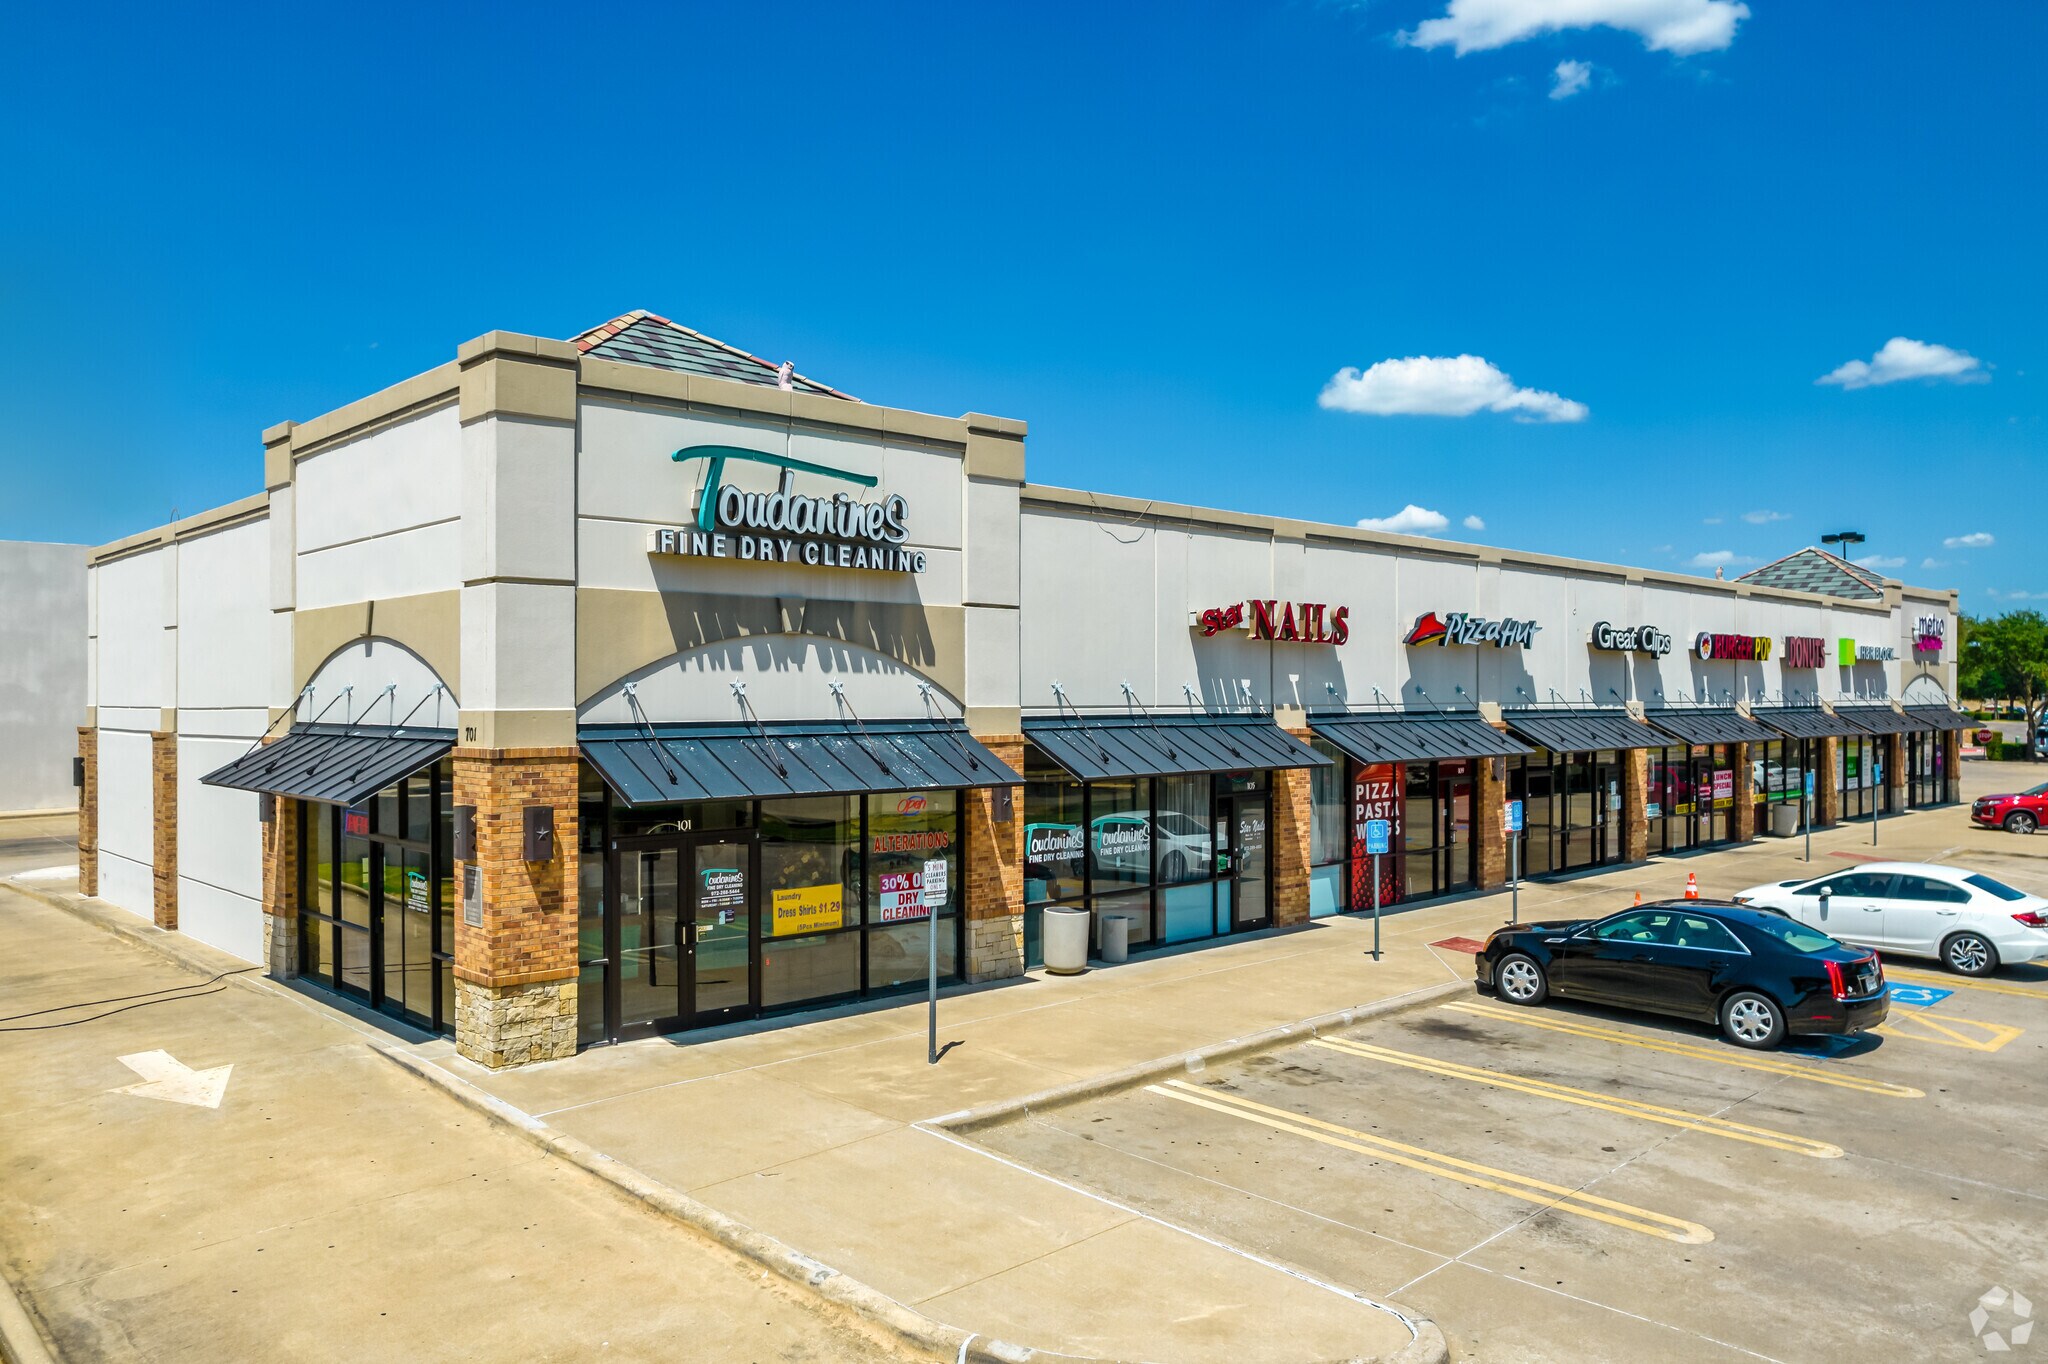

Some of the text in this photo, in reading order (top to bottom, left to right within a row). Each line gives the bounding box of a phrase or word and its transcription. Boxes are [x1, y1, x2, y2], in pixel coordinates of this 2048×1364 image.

[671, 444, 910, 544] Toudanines
[659, 529, 927, 573] FINE DRY CLEANING
[1199, 599, 1350, 646] Star NAILS
[1444, 612, 1543, 649] Pizza Hut
[1918, 612, 1945, 636] metro
[1598, 622, 1672, 658] Great Clips
[1714, 633, 1772, 661] BURGER POP
[1788, 636, 1827, 669] DONUTS
[465, 726, 477, 742] 701
[1356, 782, 1400, 801] PIZZA
[897, 798, 927, 813] Open
[1356, 801, 1400, 821] PASTA
[677, 819, 691, 831] 101
[1091, 817, 1150, 850] Toudanines
[874, 831, 949, 854] ALTERATIONS
[1023, 823, 1084, 857] Toudanines
[1100, 842, 1150, 856] FINE DRY CLEANING
[1029, 849, 1085, 864] FINE DRY CLEANING
[925, 870, 946, 879] CLEANERS
[932, 862, 944, 871] MIN
[700, 868, 744, 888] Toudanines
[881, 873, 910, 891] 30%
[926, 876, 945, 885] PARKING
[776, 892, 802, 901] Laundry
[898, 891, 919, 906] DRY
[778, 900, 841, 919] Dress Shirts $1.29
